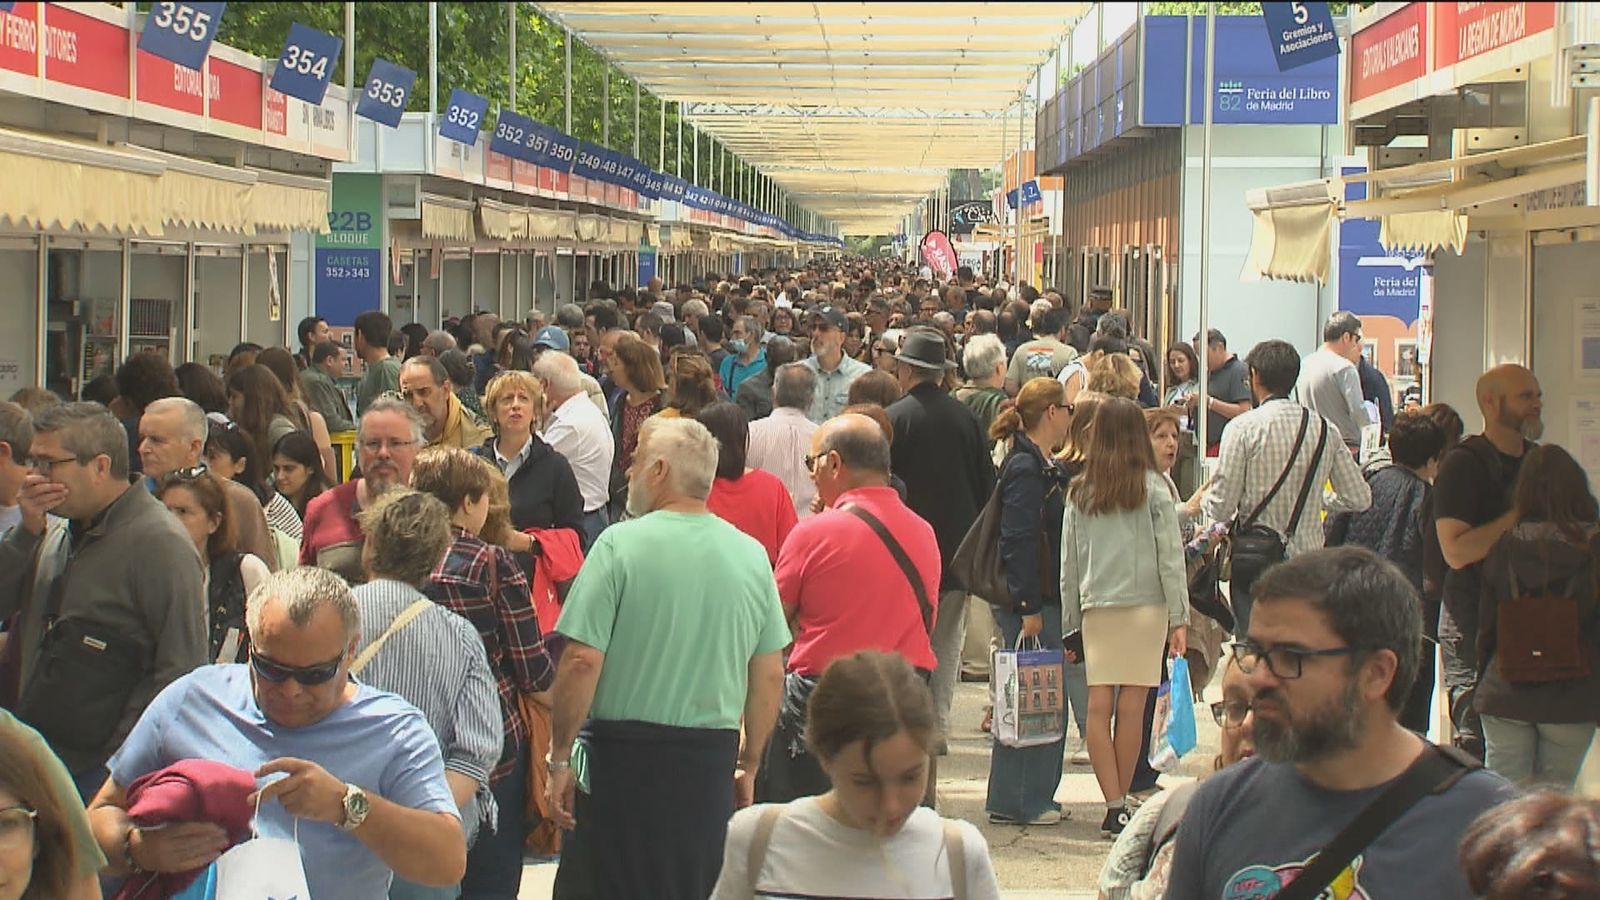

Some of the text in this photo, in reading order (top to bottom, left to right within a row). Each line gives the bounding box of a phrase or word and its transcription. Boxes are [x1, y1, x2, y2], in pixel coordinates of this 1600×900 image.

[155, 2, 211, 41] 355
[1292, 2, 1308, 24] 5
[1282, 21, 1324, 42] Gremios y
[1458, 26, 1467, 60] LA
[1490, 12, 1500, 48] DE
[45, 24, 78, 64] DITORES
[1280, 31, 1334, 54] Asociaciones
[283, 45, 328, 80] 354
[368, 78, 405, 107] 353
[1219, 95, 1241, 111] 82
[1247, 87, 1331, 100] Feria del Libro
[1246, 100, 1294, 111] de Madrid
[448, 105, 478, 130] 352
[496, 123, 523, 144] 352
[526, 133, 550, 154] 351
[550, 143, 573, 161] 350
[578, 152, 601, 170] 349
[602, 160, 617, 174] 48
[327, 211, 372, 231] 22B
[327, 232, 369, 244] BLOQUE
[1374, 276, 1418, 287] Feria del
[1373, 288, 1416, 297] de Madrid
